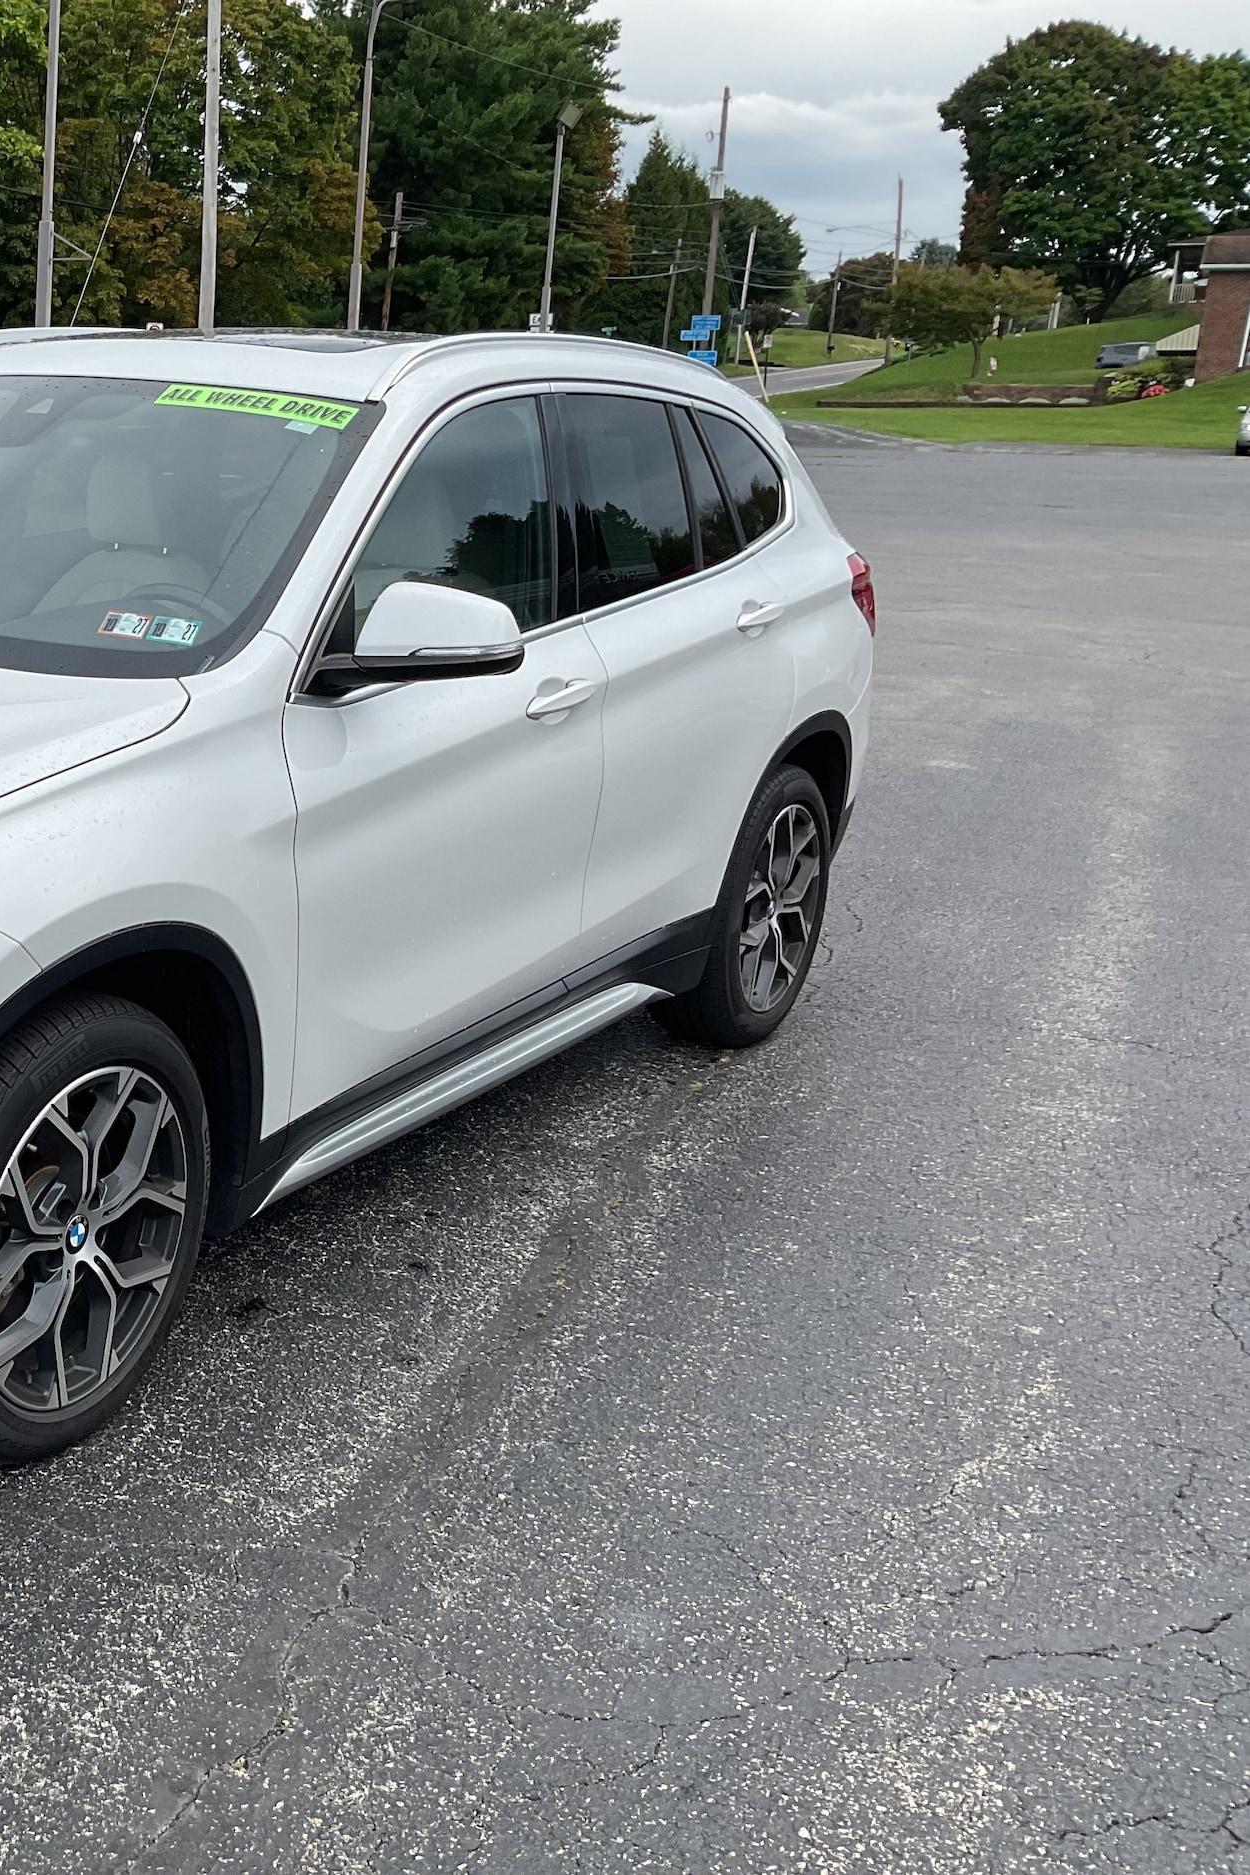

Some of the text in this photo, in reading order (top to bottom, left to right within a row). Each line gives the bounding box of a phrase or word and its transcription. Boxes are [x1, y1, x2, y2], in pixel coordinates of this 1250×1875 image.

[161, 388, 353, 424] ALL WHEEL DRIVE
[132, 617, 148, 635] 27
[181, 623, 197, 641] 27
